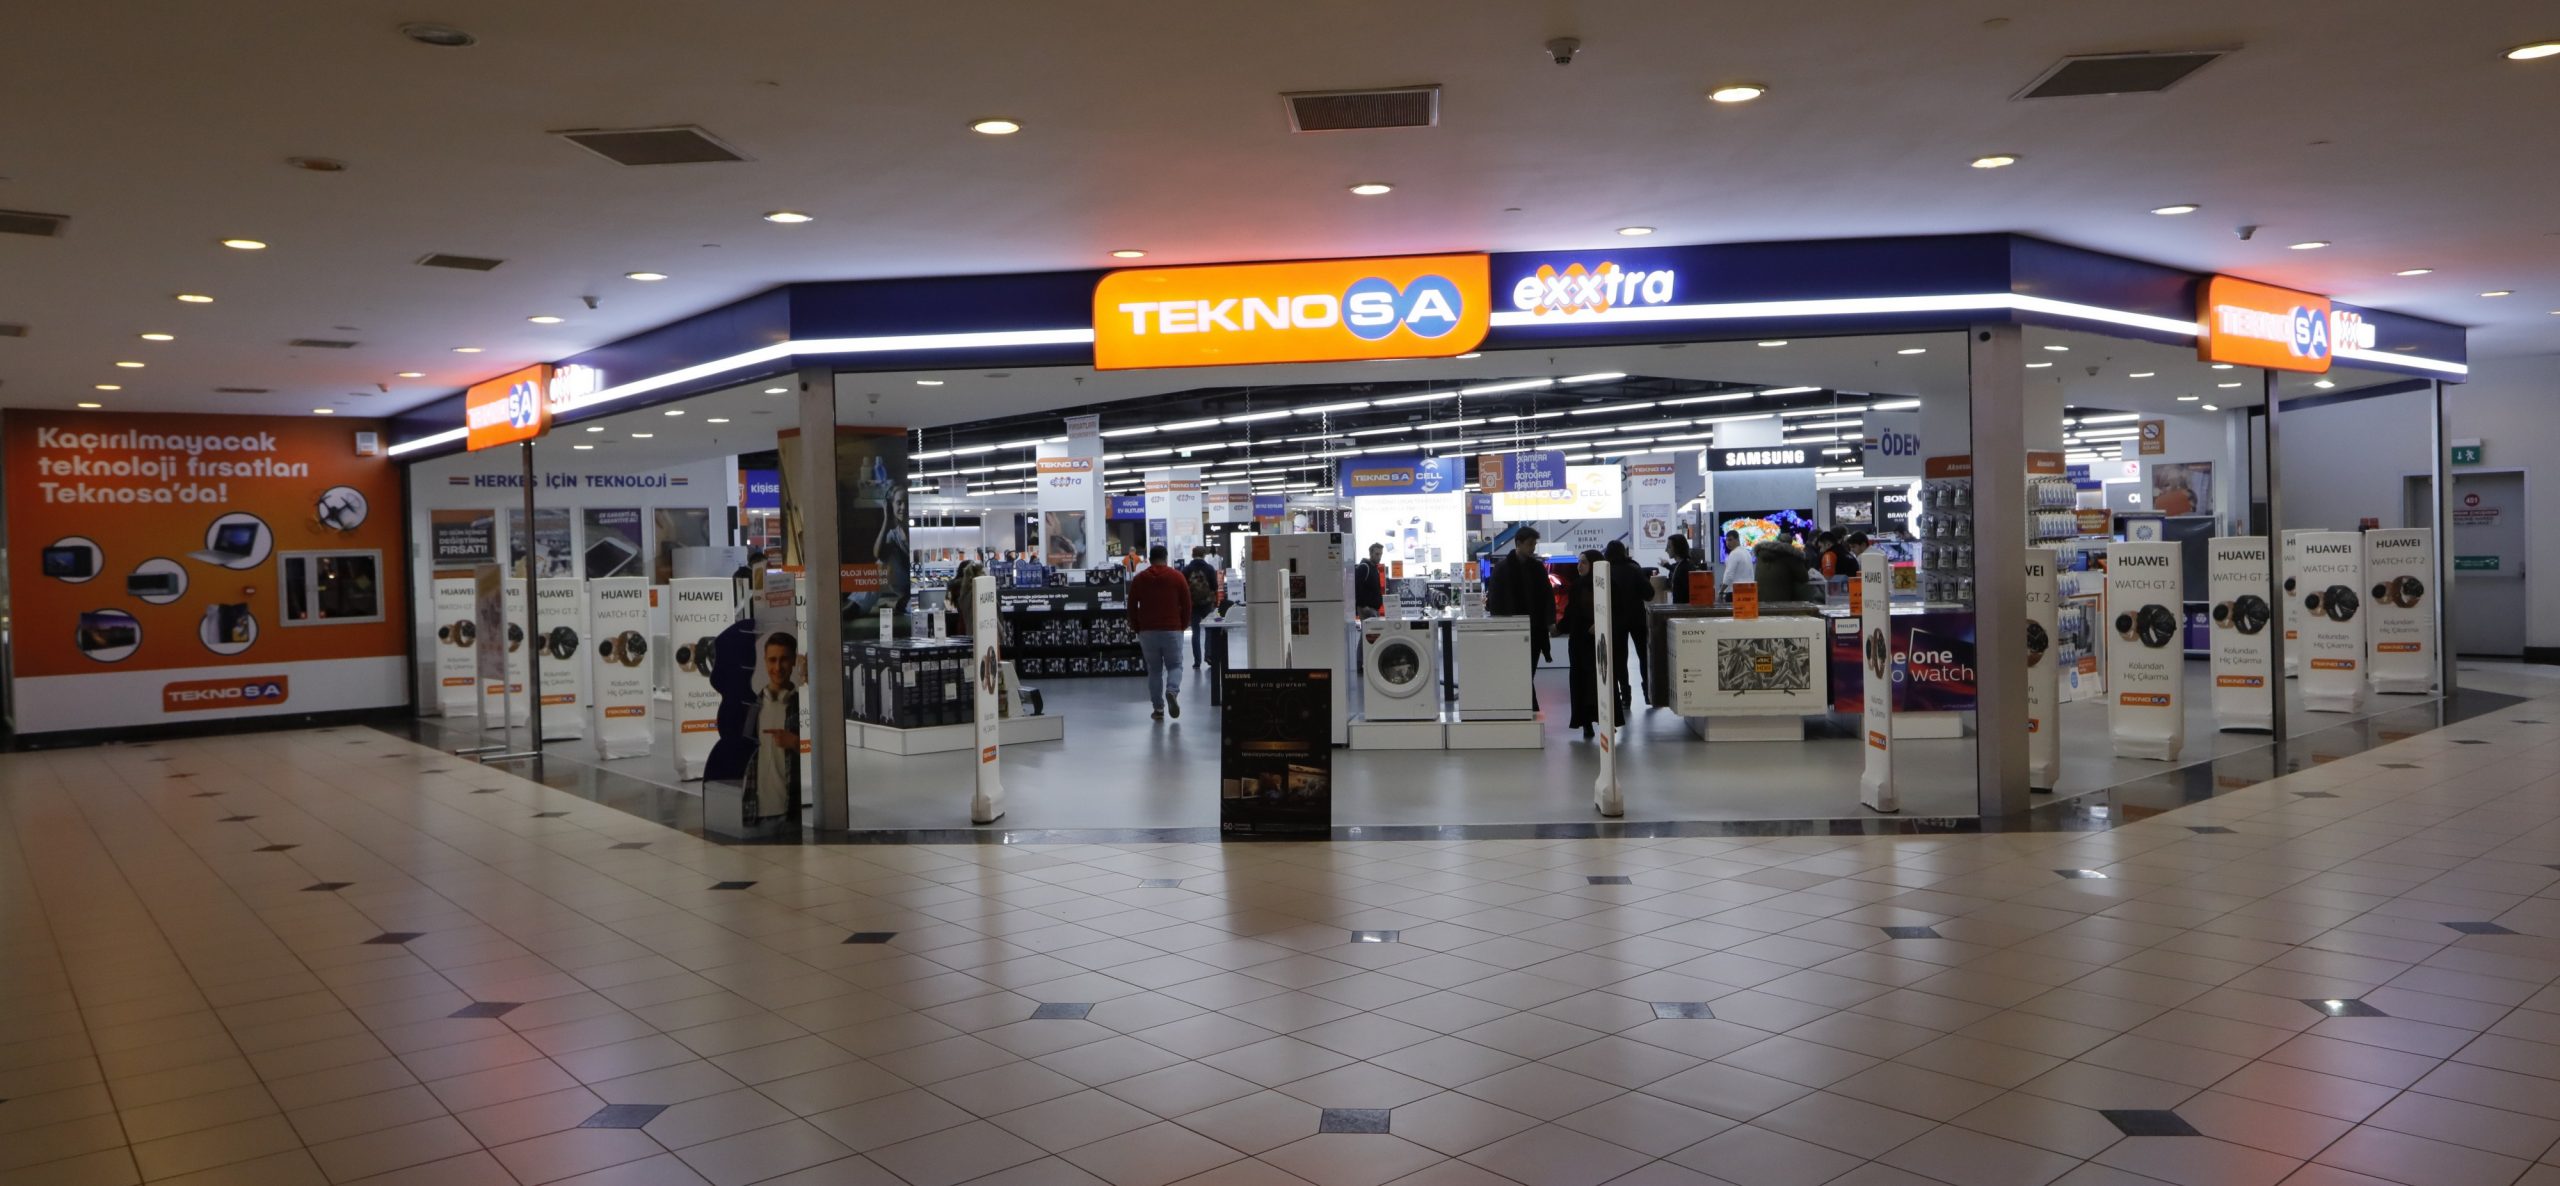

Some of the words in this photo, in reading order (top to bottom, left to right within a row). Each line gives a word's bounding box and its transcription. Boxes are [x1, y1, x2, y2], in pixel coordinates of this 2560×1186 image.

[1513, 262, 1676, 310] exxtra
[1119, 283, 1456, 337] TEKNOSA
[38, 427, 276, 455] Kaçırılmayacak
[1726, 450, 1805, 466] SAMSUNG
[38, 456, 176, 482] teknoloji
[187, 457, 309, 477] fırsatları
[1040, 461, 1089, 469] TEKNOSA
[546, 473, 577, 491] İÇİN
[585, 472, 667, 488] TEKNOLOJİ
[1354, 473, 1409, 481] TEKNOSA
[40, 482, 228, 503] Teknosa'da!
[2376, 538, 2420, 548] HUAWEI
[2306, 545, 2351, 554] HUAWEI
[2218, 551, 2265, 560] HUAWEI
[2119, 556, 2168, 566] HUAWEI
[2371, 558, 2403, 566] WATCH
[2303, 565, 2335, 573] WATCH
[1865, 571, 1881, 583] HUAWEI
[2213, 573, 2247, 582] WATCH
[2249, 573, 2262, 581] GT
[2115, 580, 2151, 589] WATCH
[2153, 580, 2166, 589] GT
[2169, 580, 2175, 588] 2
[441, 588, 474, 596] HUAWEI
[601, 589, 642, 599] HUAWEI
[679, 592, 723, 601] HUAWEI
[2027, 593, 2042, 602] GT
[2044, 593, 2050, 602] 2
[598, 610, 628, 619] WATCH
[629, 610, 640, 618] GT
[674, 614, 707, 623] WATCH
[708, 614, 721, 622] GT
[722, 613, 728, 622] 2
[1912, 650, 1953, 664] one
[2128, 662, 2164, 670] Kolundan
[1911, 663, 1974, 682] watch
[2138, 672, 2168, 681] Çıkarma
[167, 682, 281, 702] TEKNOSA
